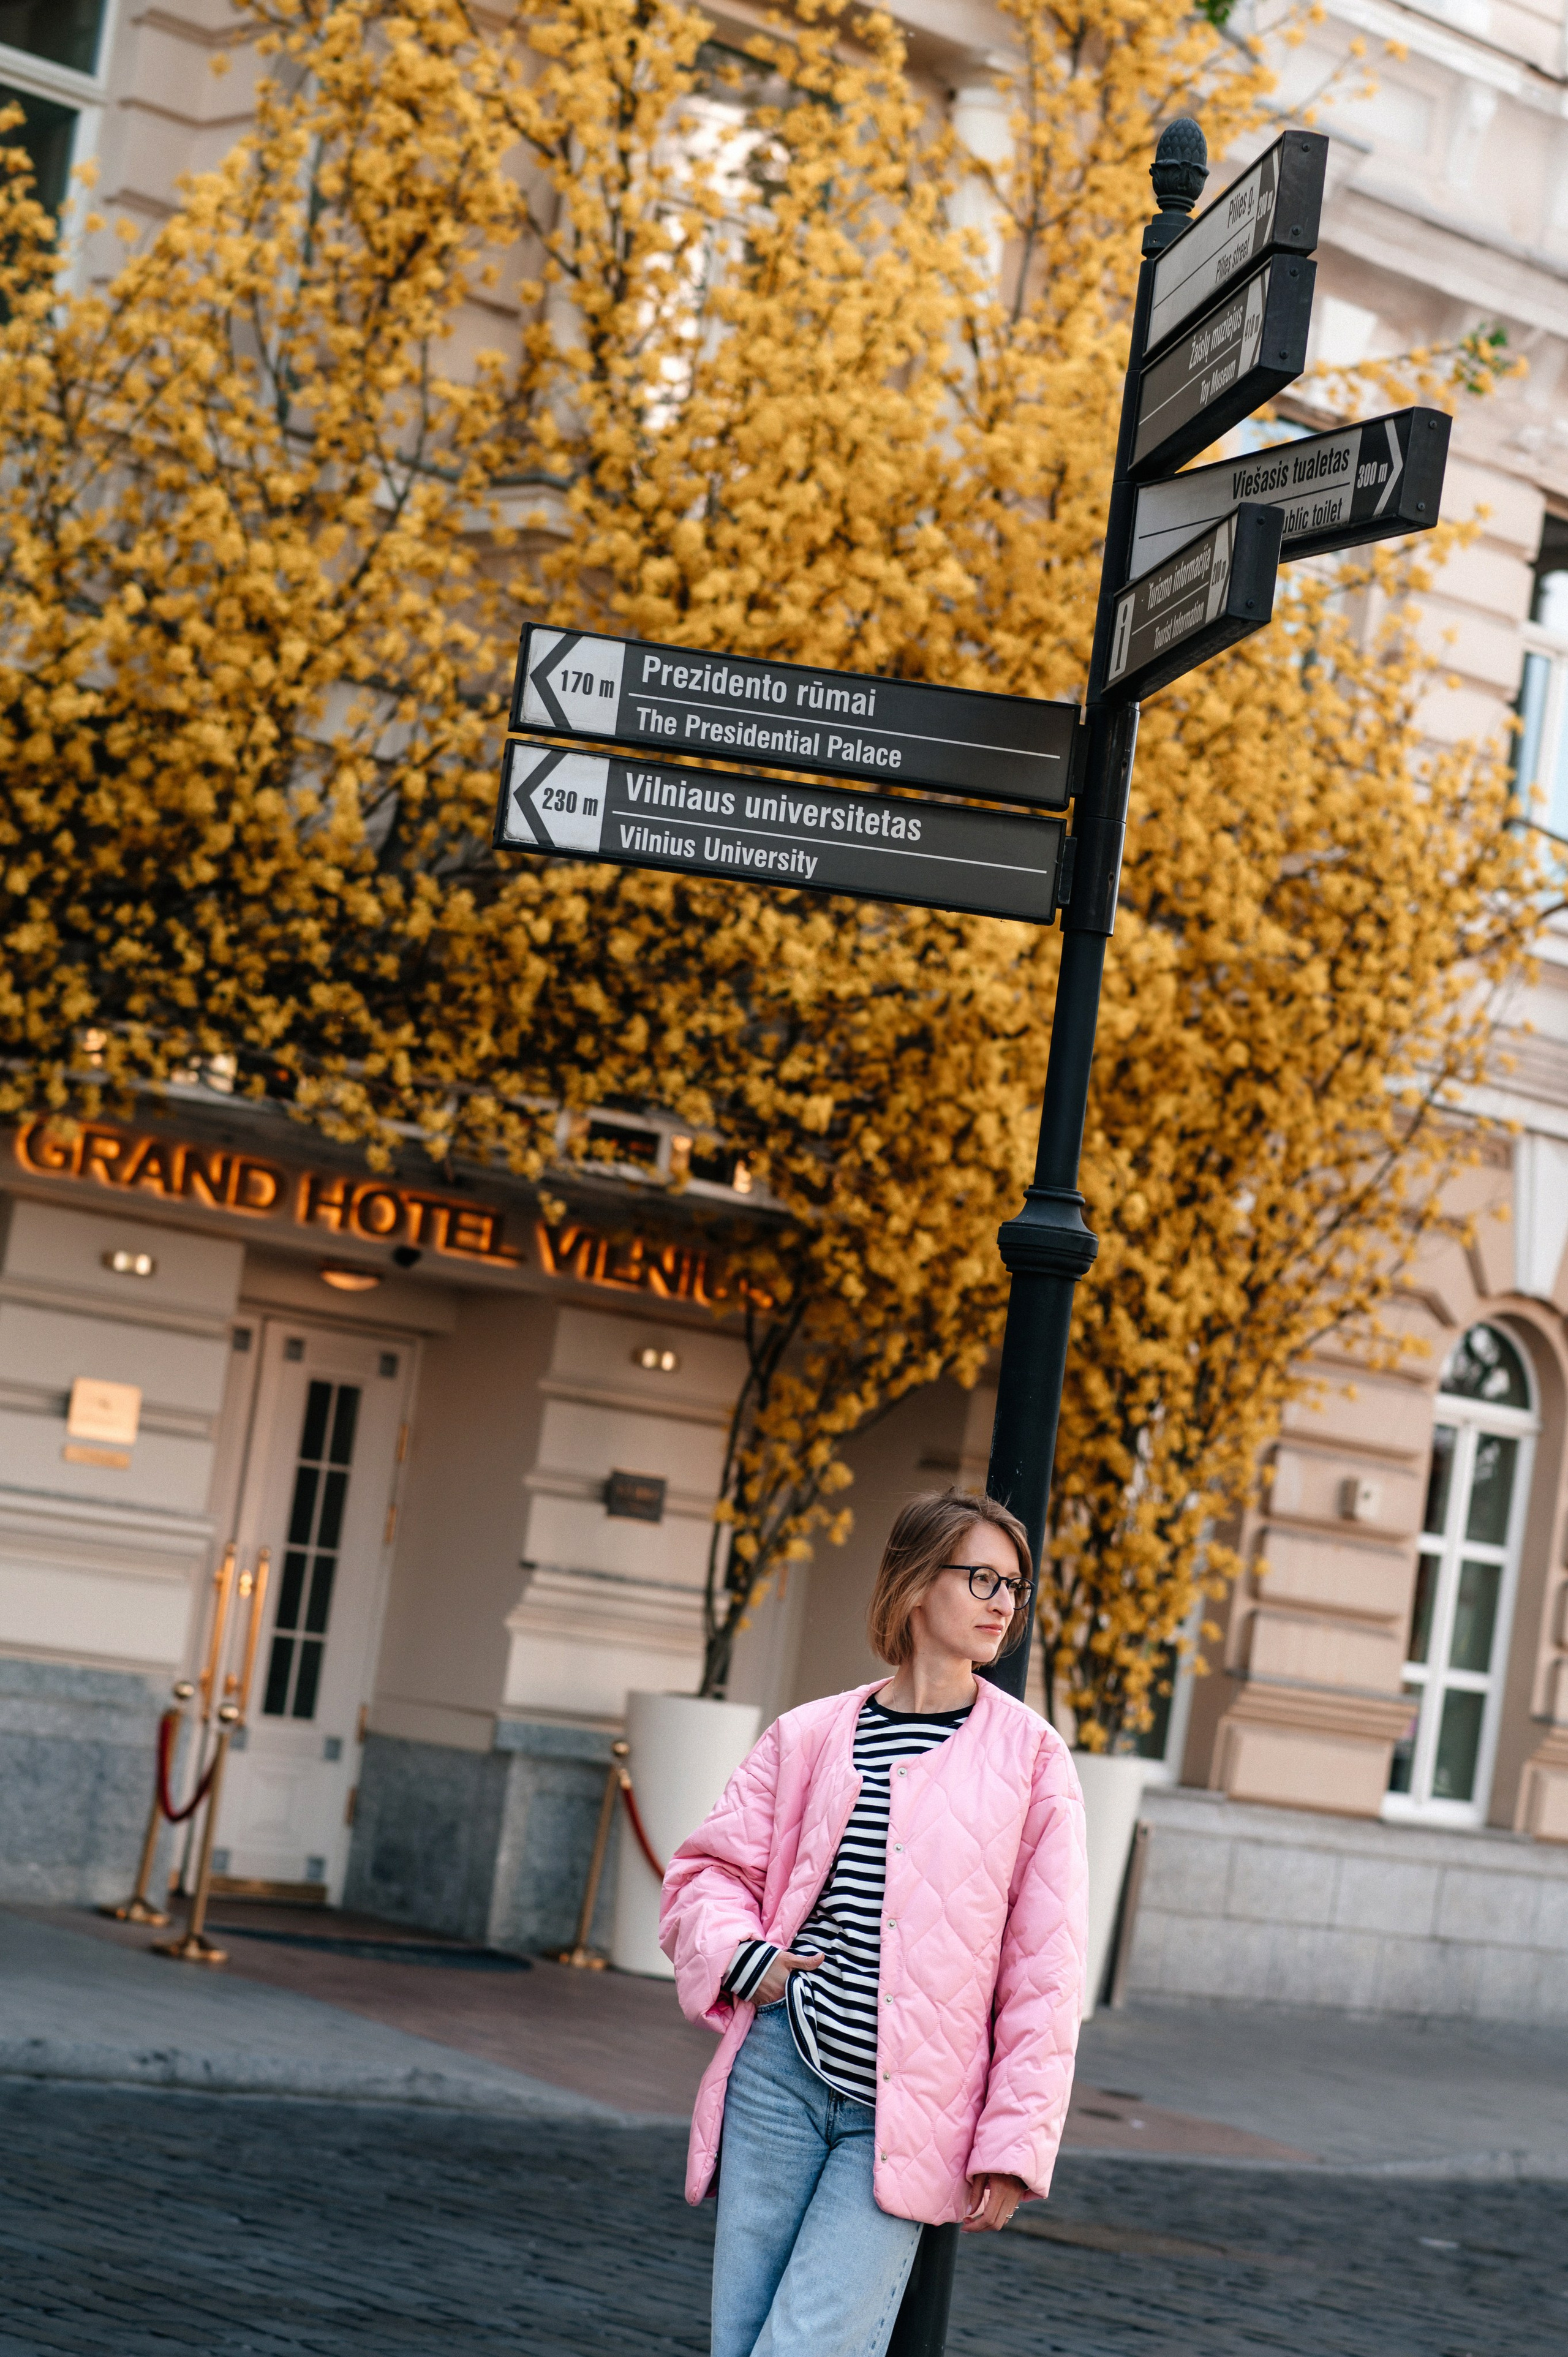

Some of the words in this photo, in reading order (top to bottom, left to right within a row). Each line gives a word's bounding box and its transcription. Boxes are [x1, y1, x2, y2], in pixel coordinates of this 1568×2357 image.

[1227, 192, 1247, 229] Pilies
[1248, 186, 1254, 216] g.
[1215, 254, 1231, 284] Pilies
[1232, 233, 1250, 268] street
[1189, 330, 1211, 371] Žaislų
[1210, 306, 1243, 352] muziejus
[1200, 380, 1211, 405] Toy
[1210, 359, 1236, 396] Museum
[1233, 461, 1289, 500] Viešasis
[1293, 448, 1350, 484] tualetas
[1357, 461, 1378, 488] 300
[1378, 462, 1389, 483] m
[1312, 497, 1343, 526] toilet
[1147, 575, 1173, 611] Turizmo
[1172, 543, 1212, 594] informacija
[1154, 618, 1173, 651] Tourist
[1172, 600, 1205, 638] Information
[560, 669, 594, 696] 170
[599, 679, 615, 699] m
[641, 655, 788, 704] Prezidento
[796, 681, 876, 717] rūmai
[636, 706, 677, 736] The
[685, 714, 820, 756] Presidential
[827, 734, 902, 768] Palace
[541, 787, 577, 813] 230
[582, 796, 598, 816] m
[626, 772, 736, 815] Vilniaus
[745, 794, 922, 841] universitetas
[620, 824, 696, 858] Vilnius
[704, 837, 818, 880] University
[15, 1121, 285, 1219] GRAND
[296, 1170, 527, 1269] HOTEL
